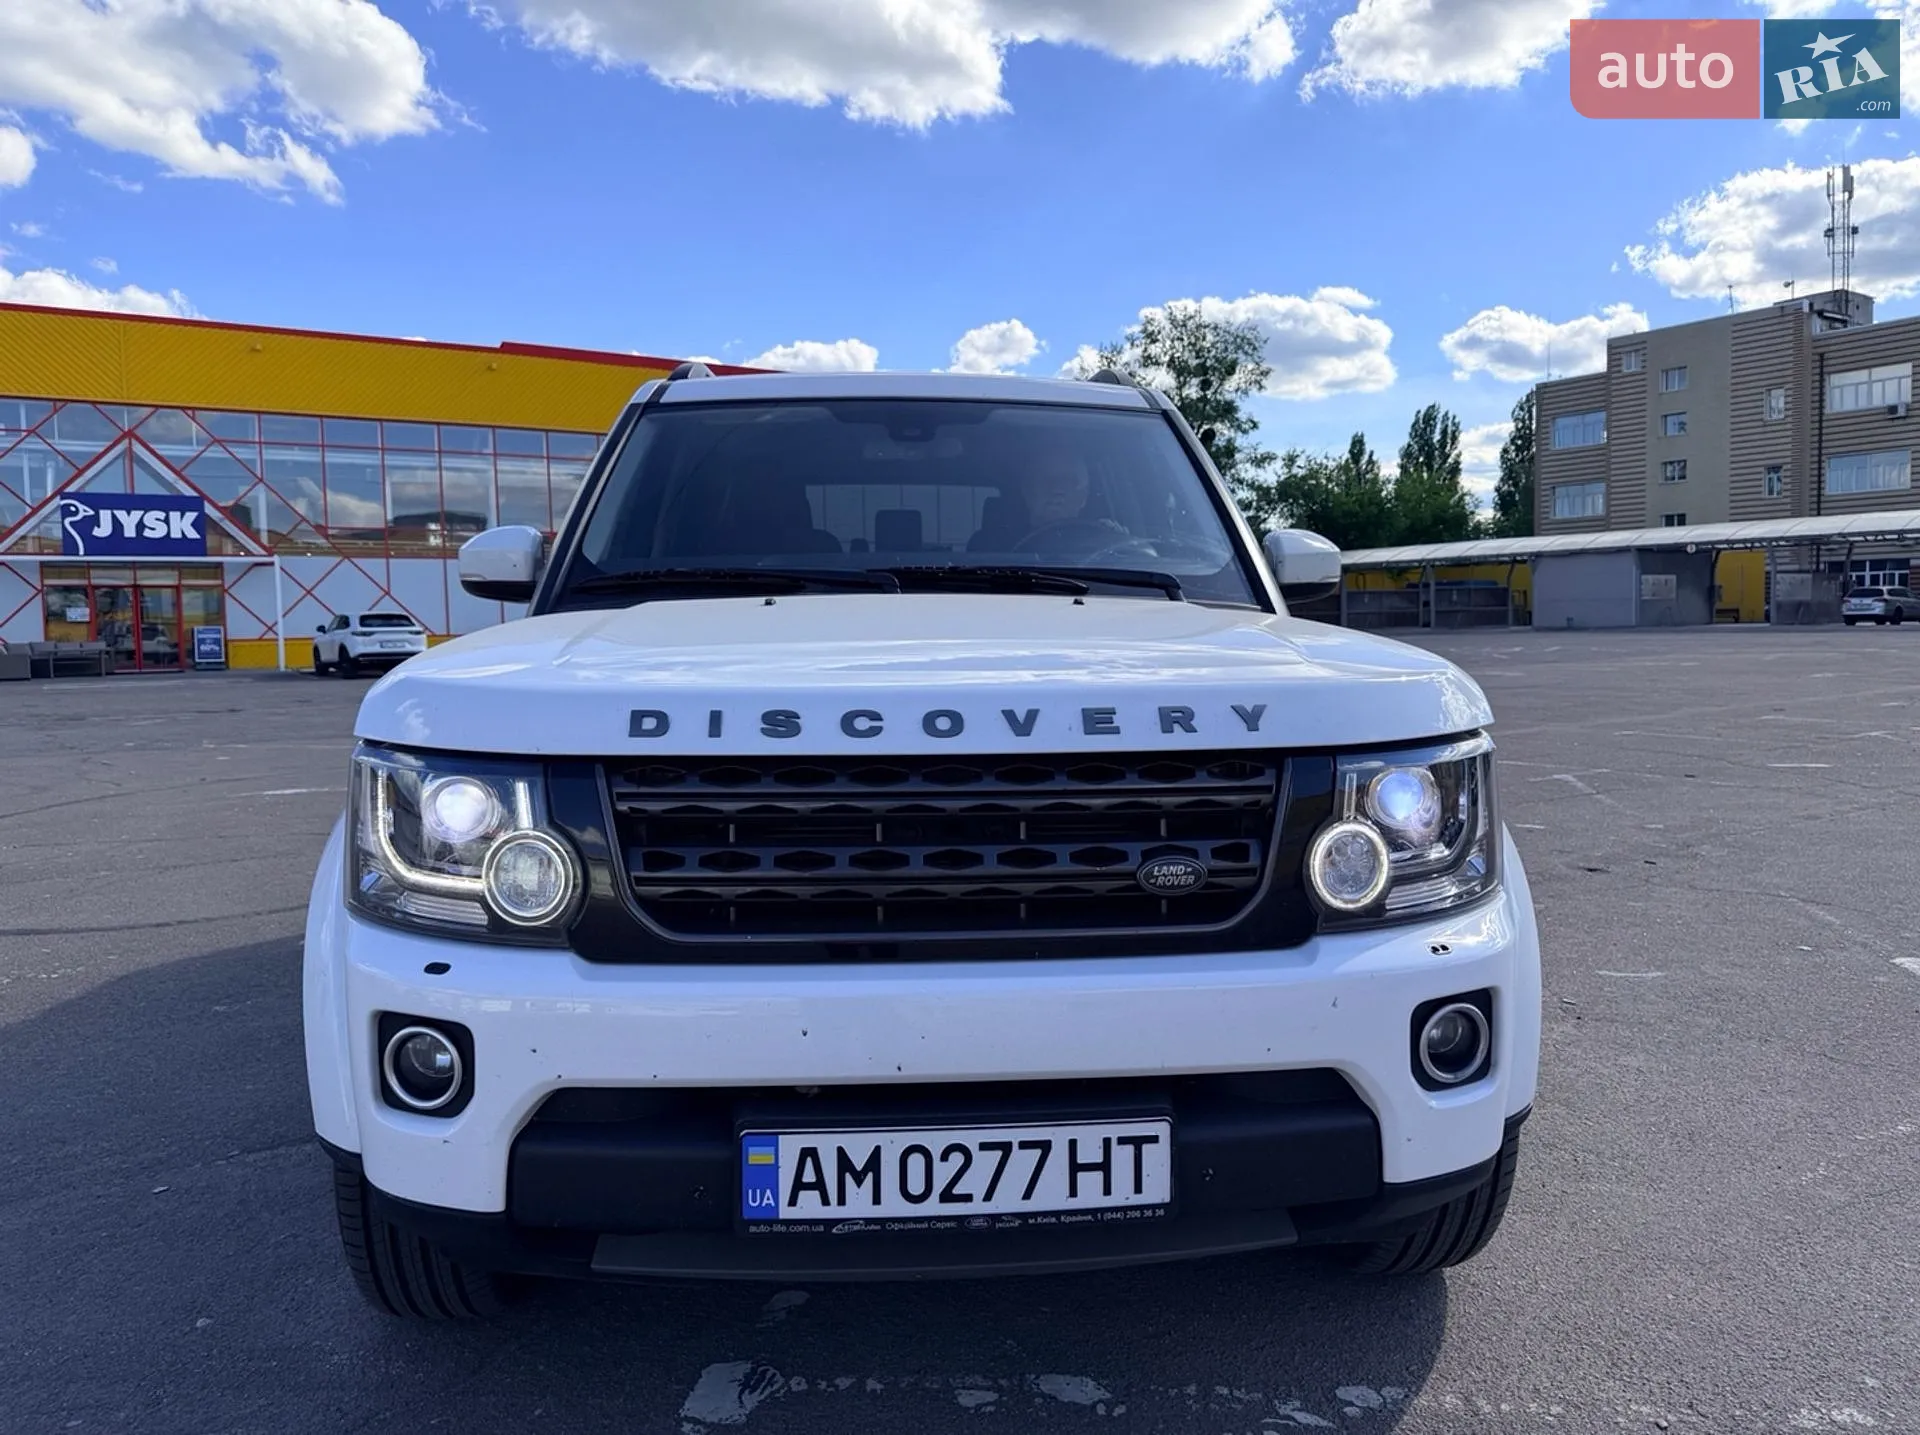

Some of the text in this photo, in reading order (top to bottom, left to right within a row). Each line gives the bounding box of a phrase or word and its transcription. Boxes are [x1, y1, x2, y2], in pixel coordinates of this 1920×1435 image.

[92, 509, 201, 539] JYSK
[628, 704, 1268, 738] DISCOVERY
[787, 1135, 1160, 1207] AM 0277 HT
[748, 1188, 775, 1208] UA
[748, 1223, 825, 1233] auto-life.com.ua
